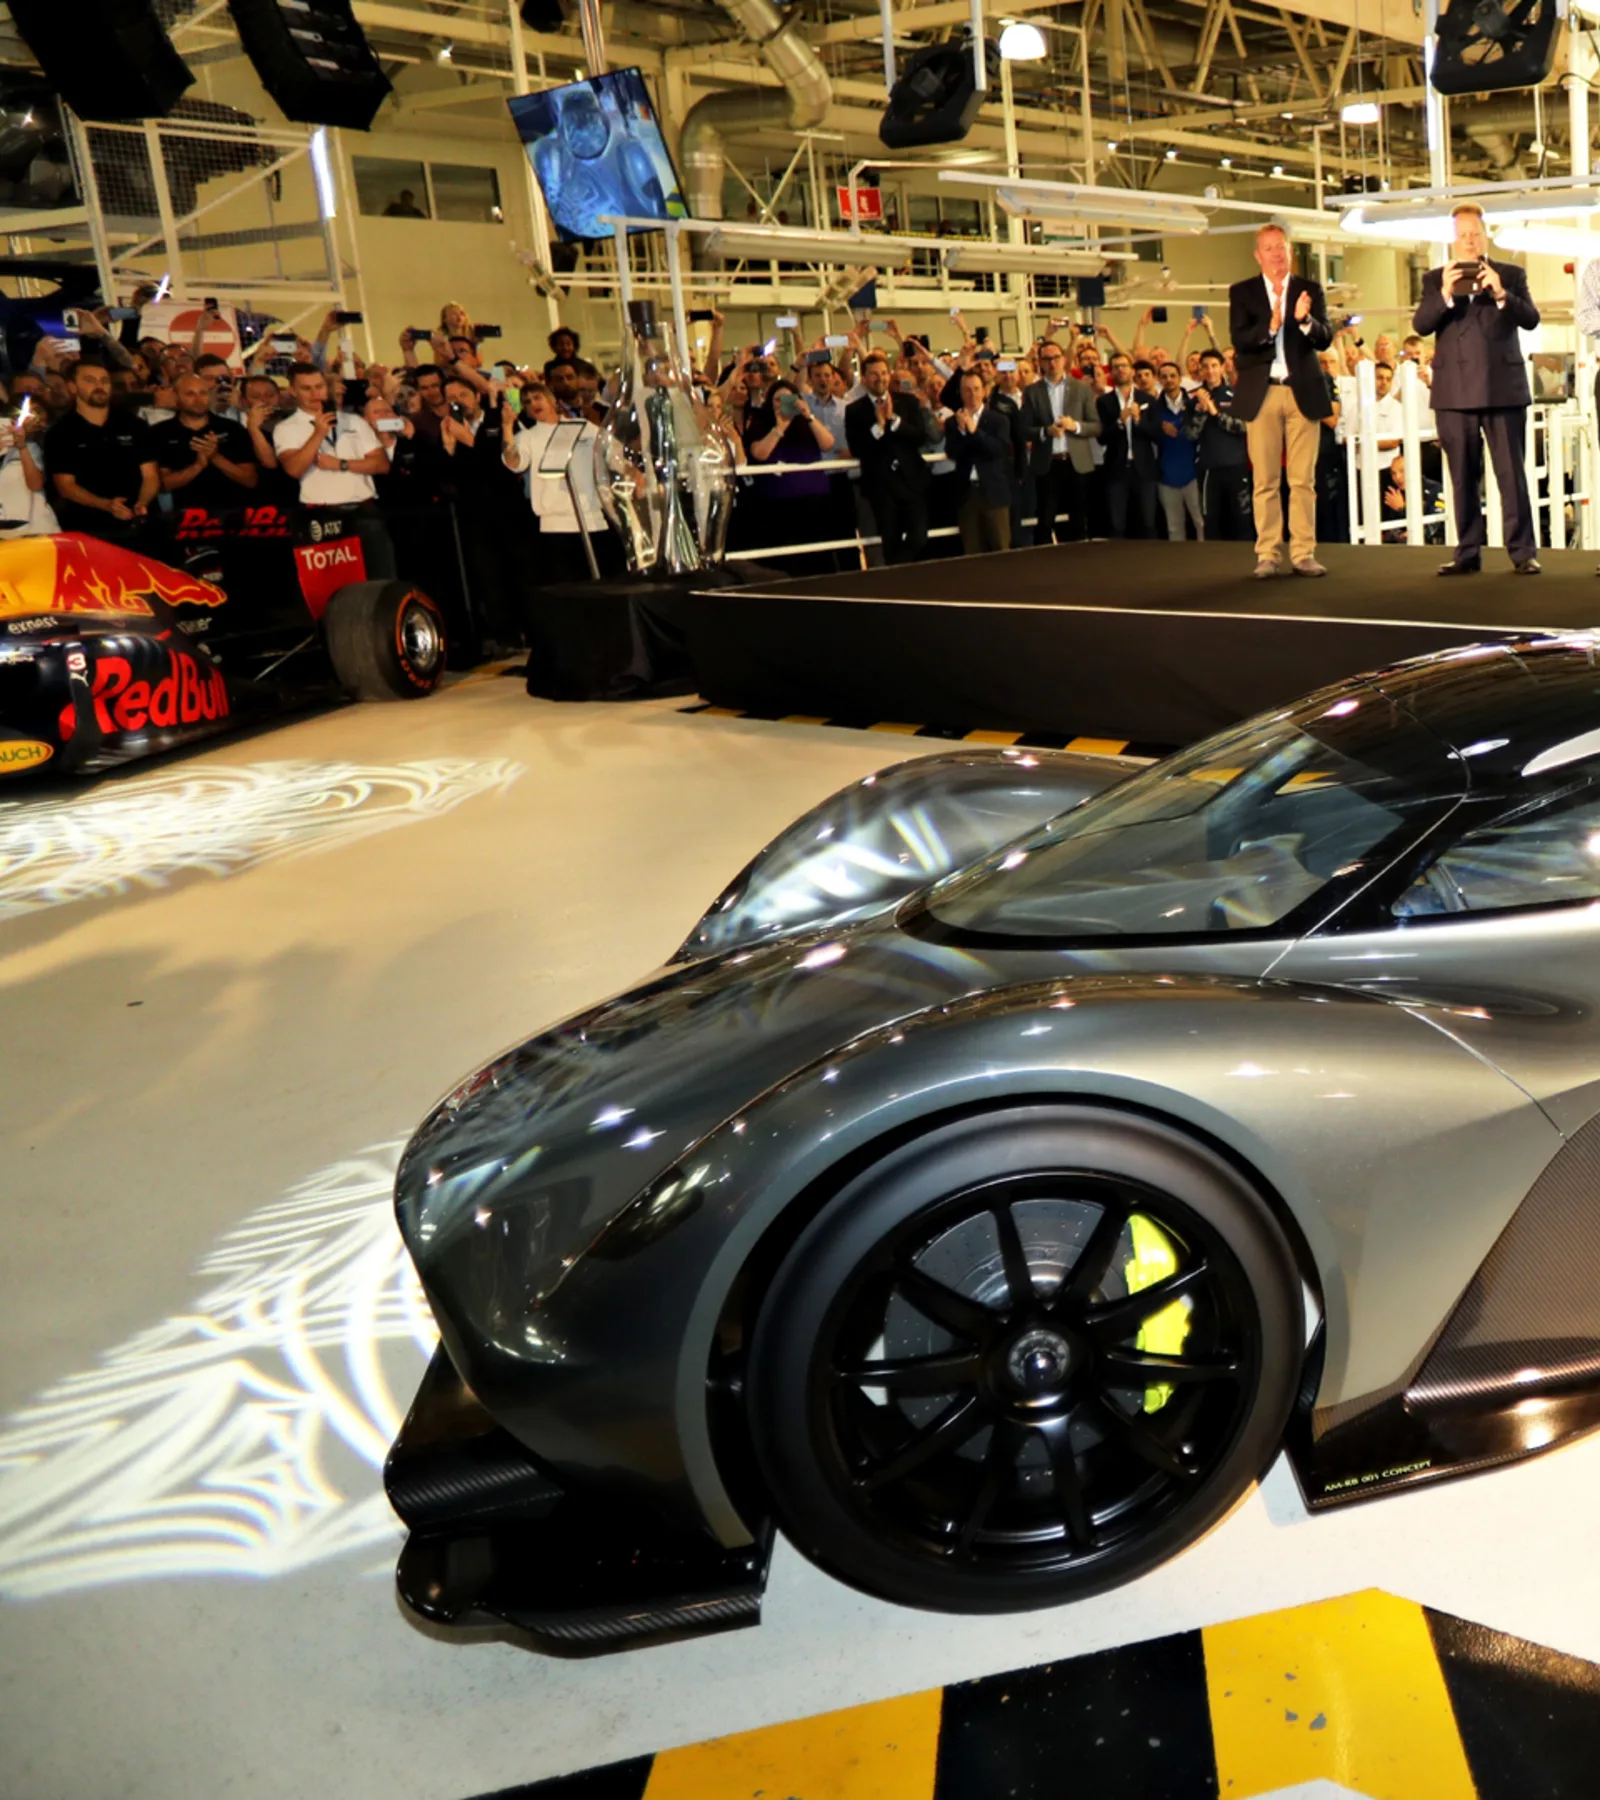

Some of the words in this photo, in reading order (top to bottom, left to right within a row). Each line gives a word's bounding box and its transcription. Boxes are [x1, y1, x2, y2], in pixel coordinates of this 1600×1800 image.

[301, 545, 358, 571] TOTAL
[66, 652, 87, 671] 3
[59, 648, 178, 741] Red
[179, 652, 230, 725] Bull
[1324, 1478, 1359, 1492] AM-RB
[1361, 1473, 1379, 1483] 001
[1381, 1460, 1431, 1478] CONCEPT
